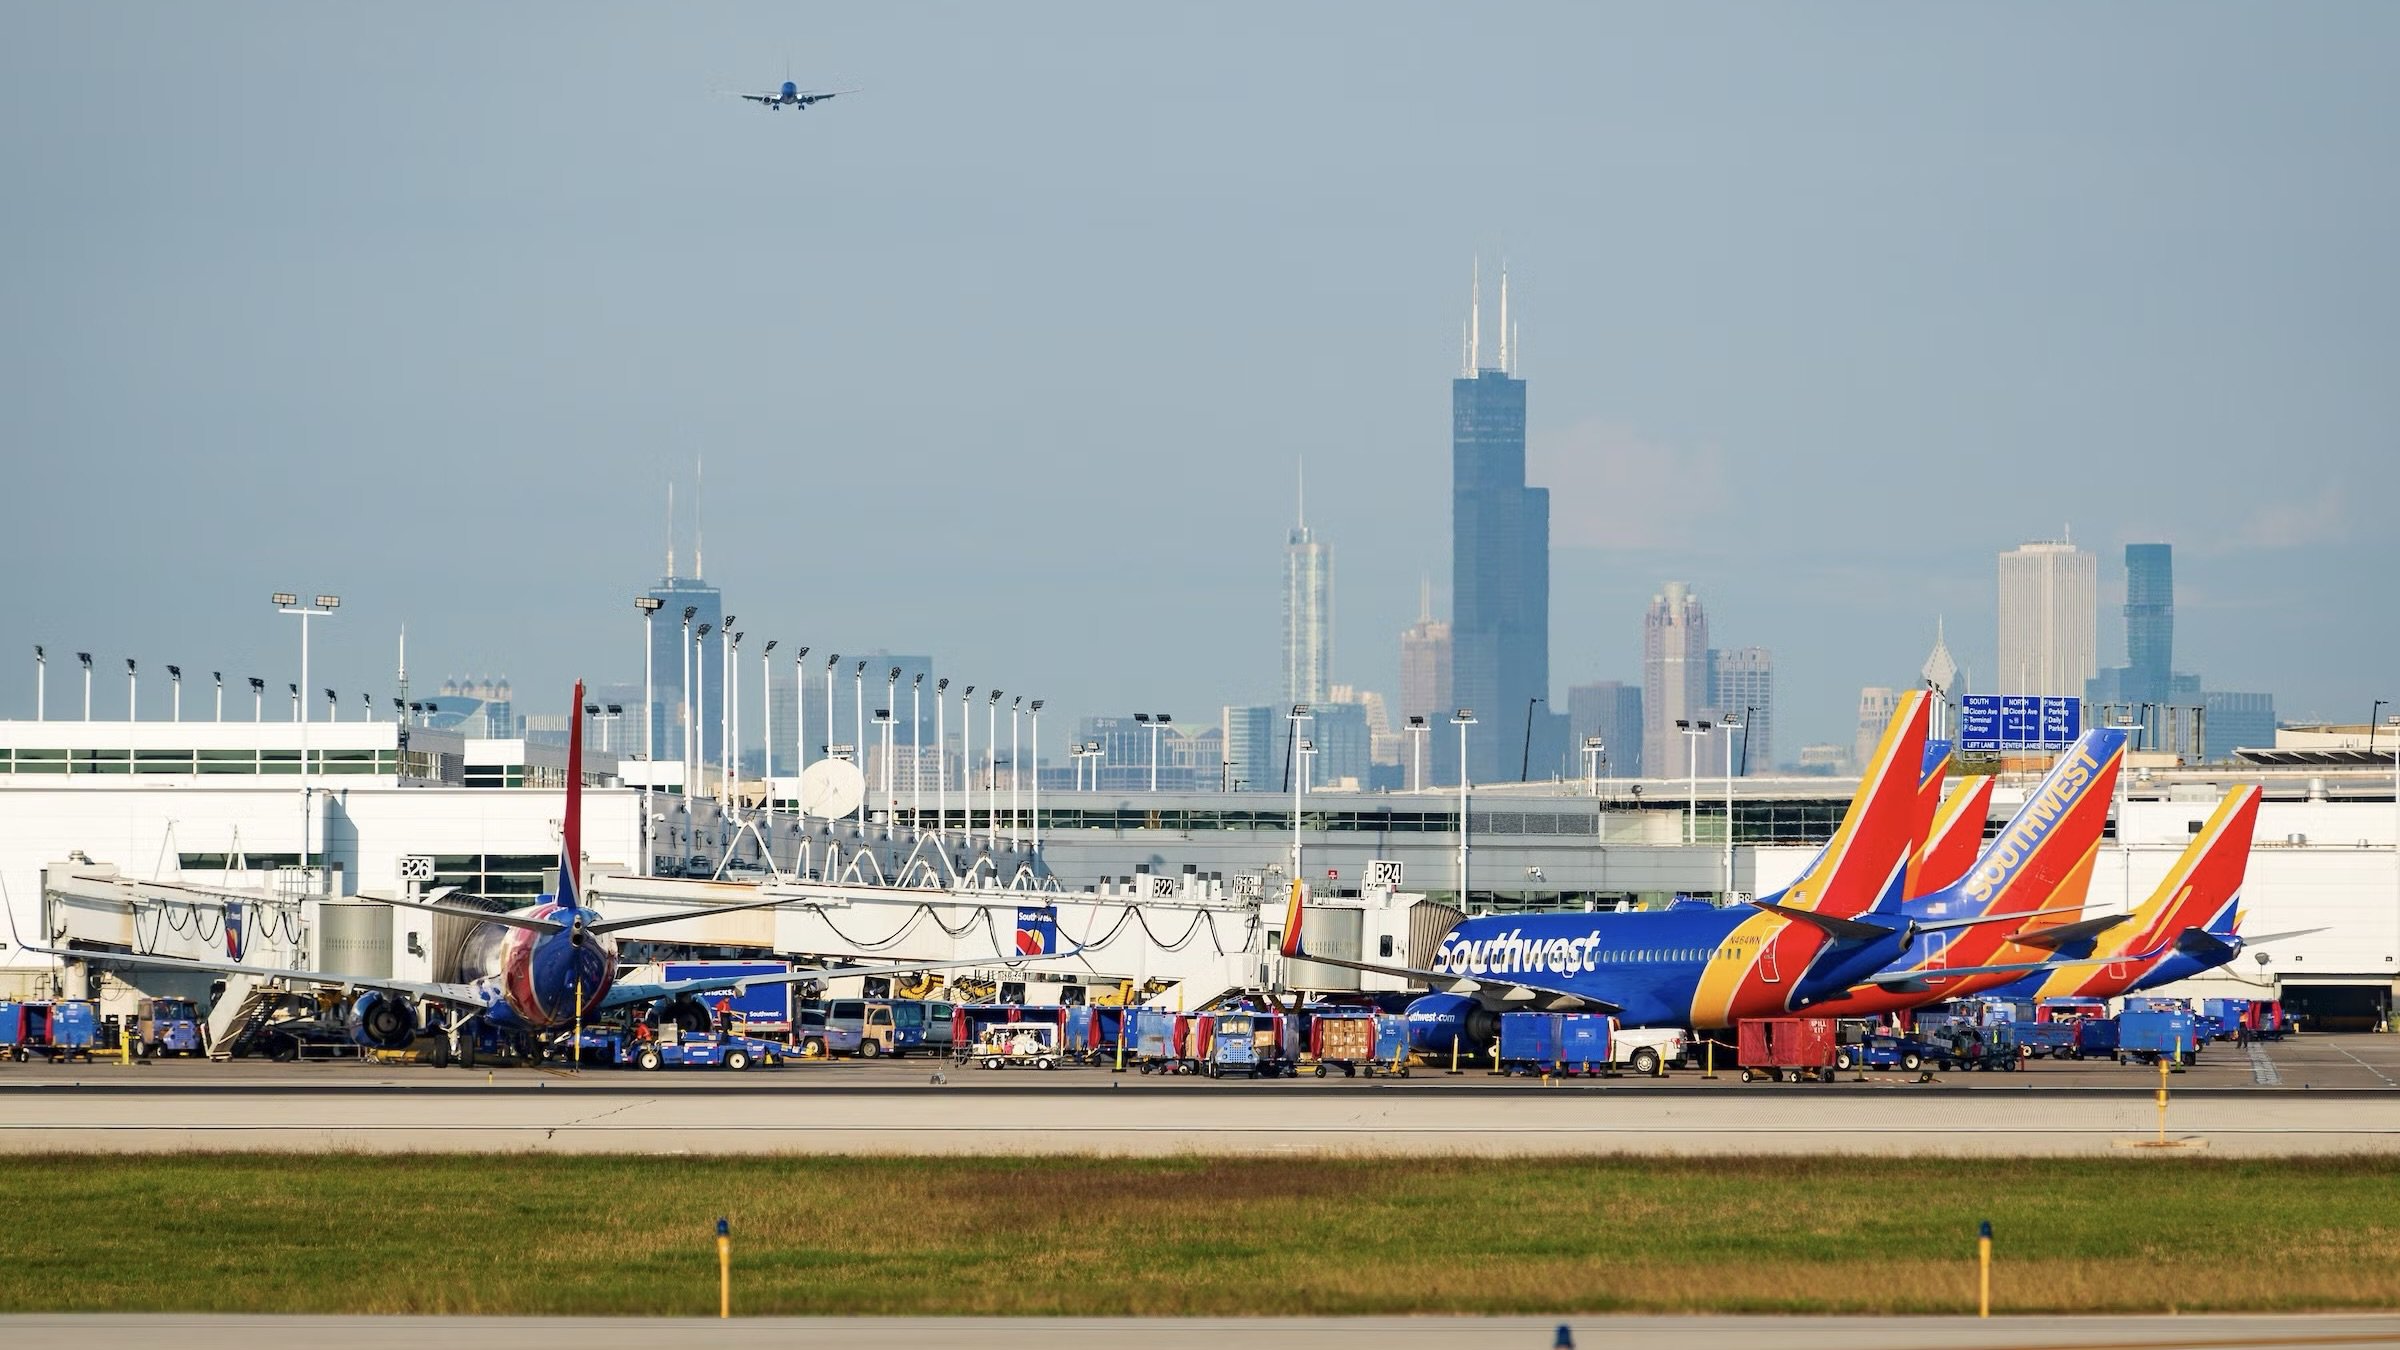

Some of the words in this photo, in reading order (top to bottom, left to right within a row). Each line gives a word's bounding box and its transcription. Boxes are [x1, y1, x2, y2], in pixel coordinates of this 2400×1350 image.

[1969, 707, 1987, 715] Cicero
[1969, 716, 1992, 724] Terminal
[2048, 717, 2062, 725] Daily
[1969, 725, 1988, 733] Garage
[1967, 744, 2099, 902] SOUTHWEST
[400, 859, 429, 879] B26
[1376, 863, 1401, 884] B24
[1153, 879, 1174, 898] B22
[1433, 928, 1601, 975] Southwest
[749, 1010, 779, 1018] Southwest
[1810, 1020, 1827, 1028] SPILL
